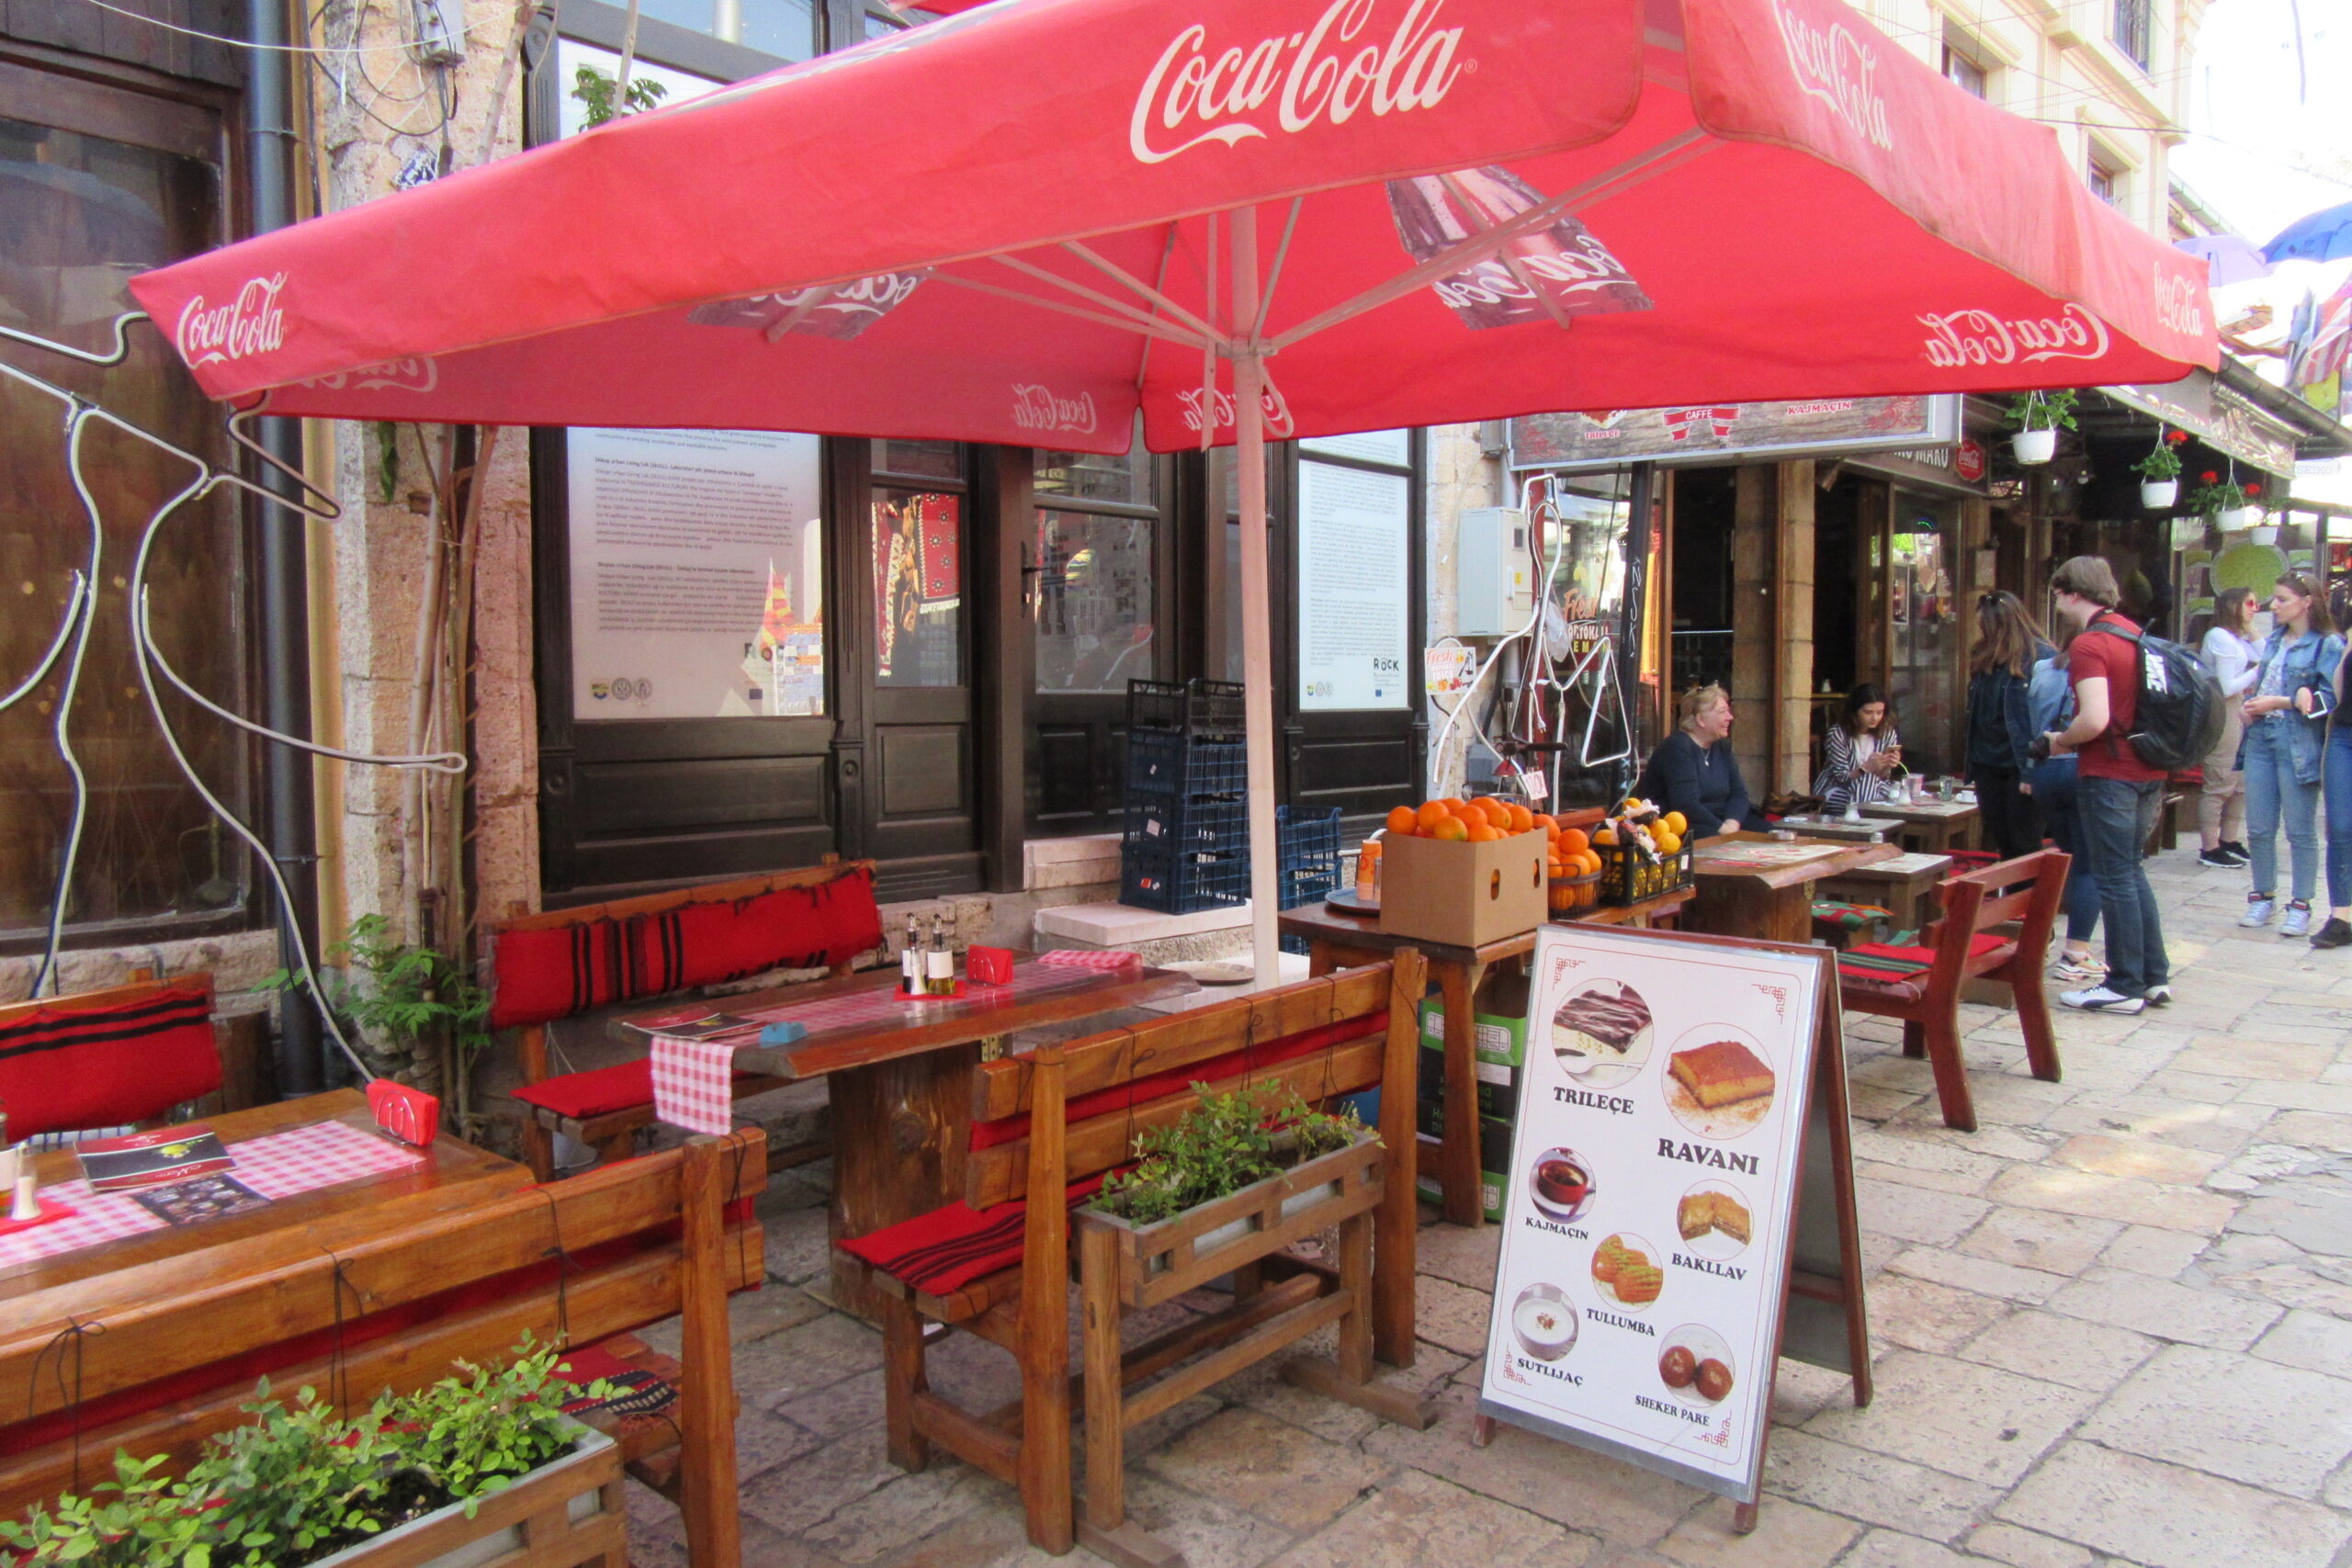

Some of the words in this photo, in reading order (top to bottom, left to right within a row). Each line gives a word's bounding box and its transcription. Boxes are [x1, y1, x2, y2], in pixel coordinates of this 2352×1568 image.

[1130, 0, 1464, 164] Coca-Cola
[176, 271, 288, 369] Coca-Cola
[1685, 409, 1714, 420] CAFFE
[1786, 400, 1852, 414] KAJMAÇIN
[1553, 1087, 1634, 1115] TRILEÇE
[1657, 1138, 1760, 1176] RAVANI
[1525, 1217, 1589, 1240] KAJMAÇIN
[1671, 1253, 1747, 1281] BAKLLAV
[1586, 1308, 1657, 1337] TULLUMBA
[1516, 1358, 1584, 1388] SUTLIJAÇ
[1634, 1394, 1679, 1418] SHEKER
[1680, 1409, 1711, 1427] PARE
